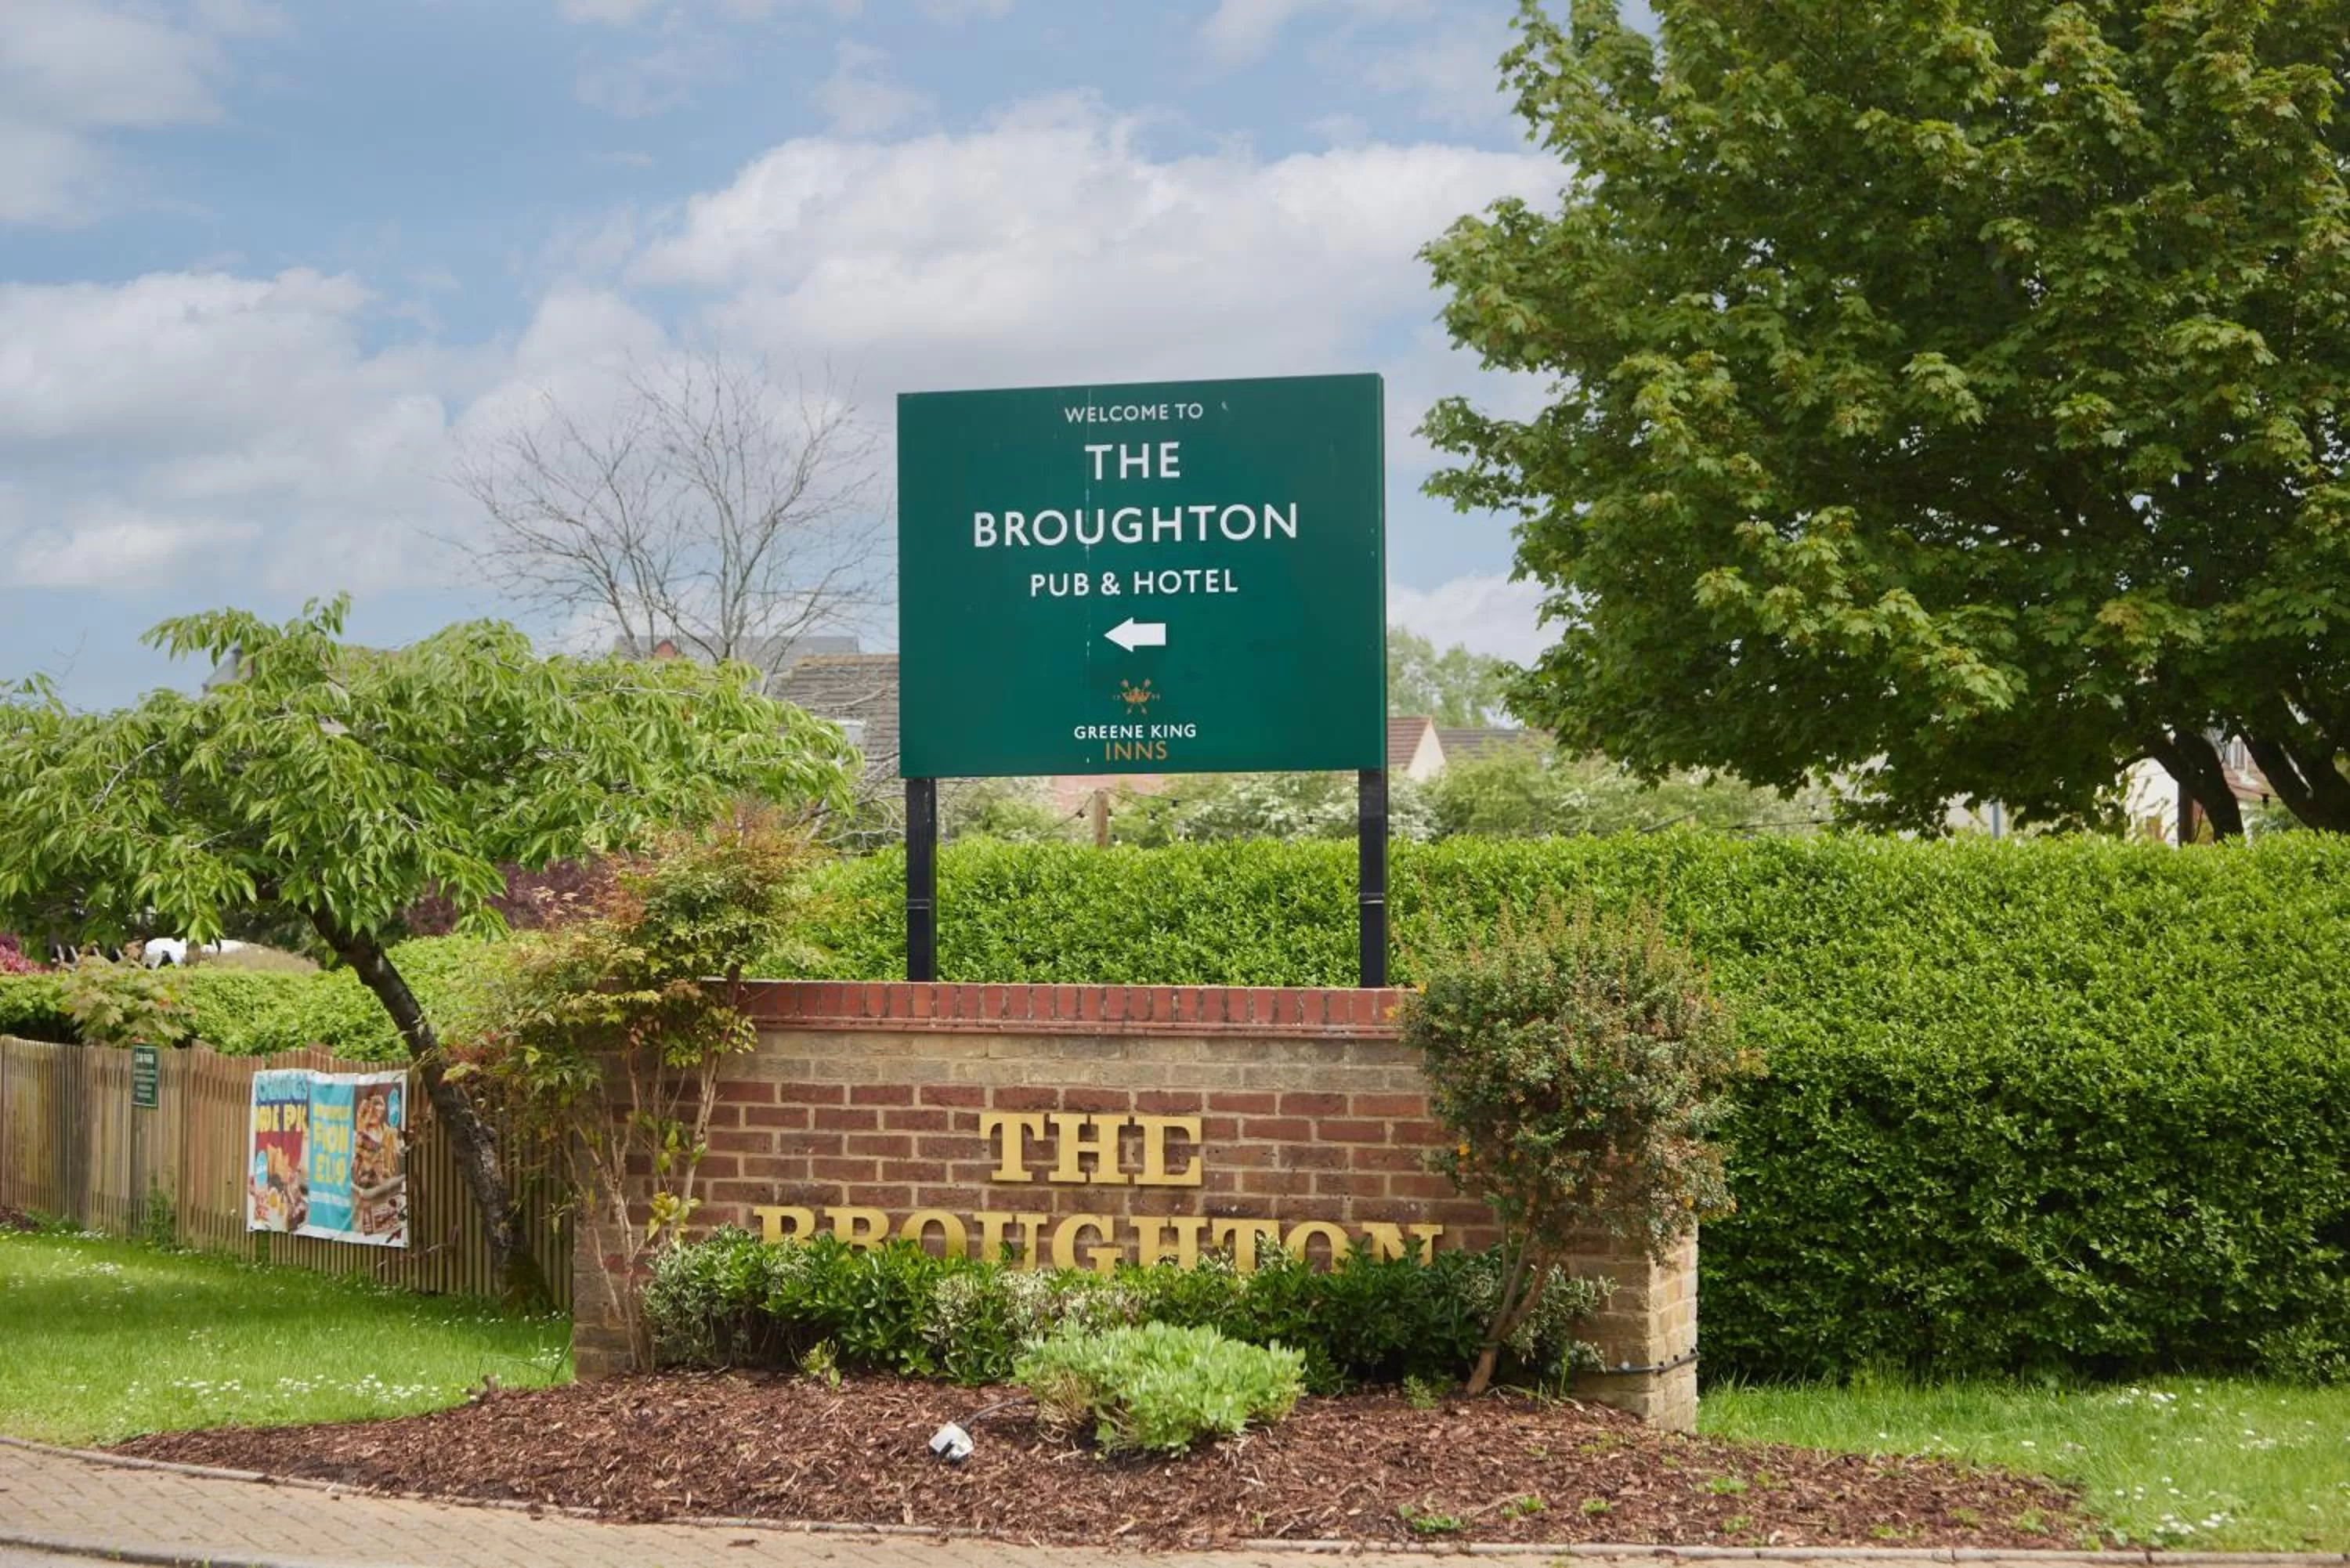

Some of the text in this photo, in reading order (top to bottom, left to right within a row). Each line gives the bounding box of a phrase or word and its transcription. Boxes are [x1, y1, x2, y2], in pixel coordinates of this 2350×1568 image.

[1065, 403, 1204, 423] WELCOME TO
[1084, 441, 1180, 480] THE
[974, 502, 1297, 547] BROUGHTON
[1030, 569, 1238, 597] PUB & HOTEL
[1074, 724, 1196, 739] GREENE KING
[1105, 740, 1168, 761] INNS
[978, 1111, 1202, 1186] THE
